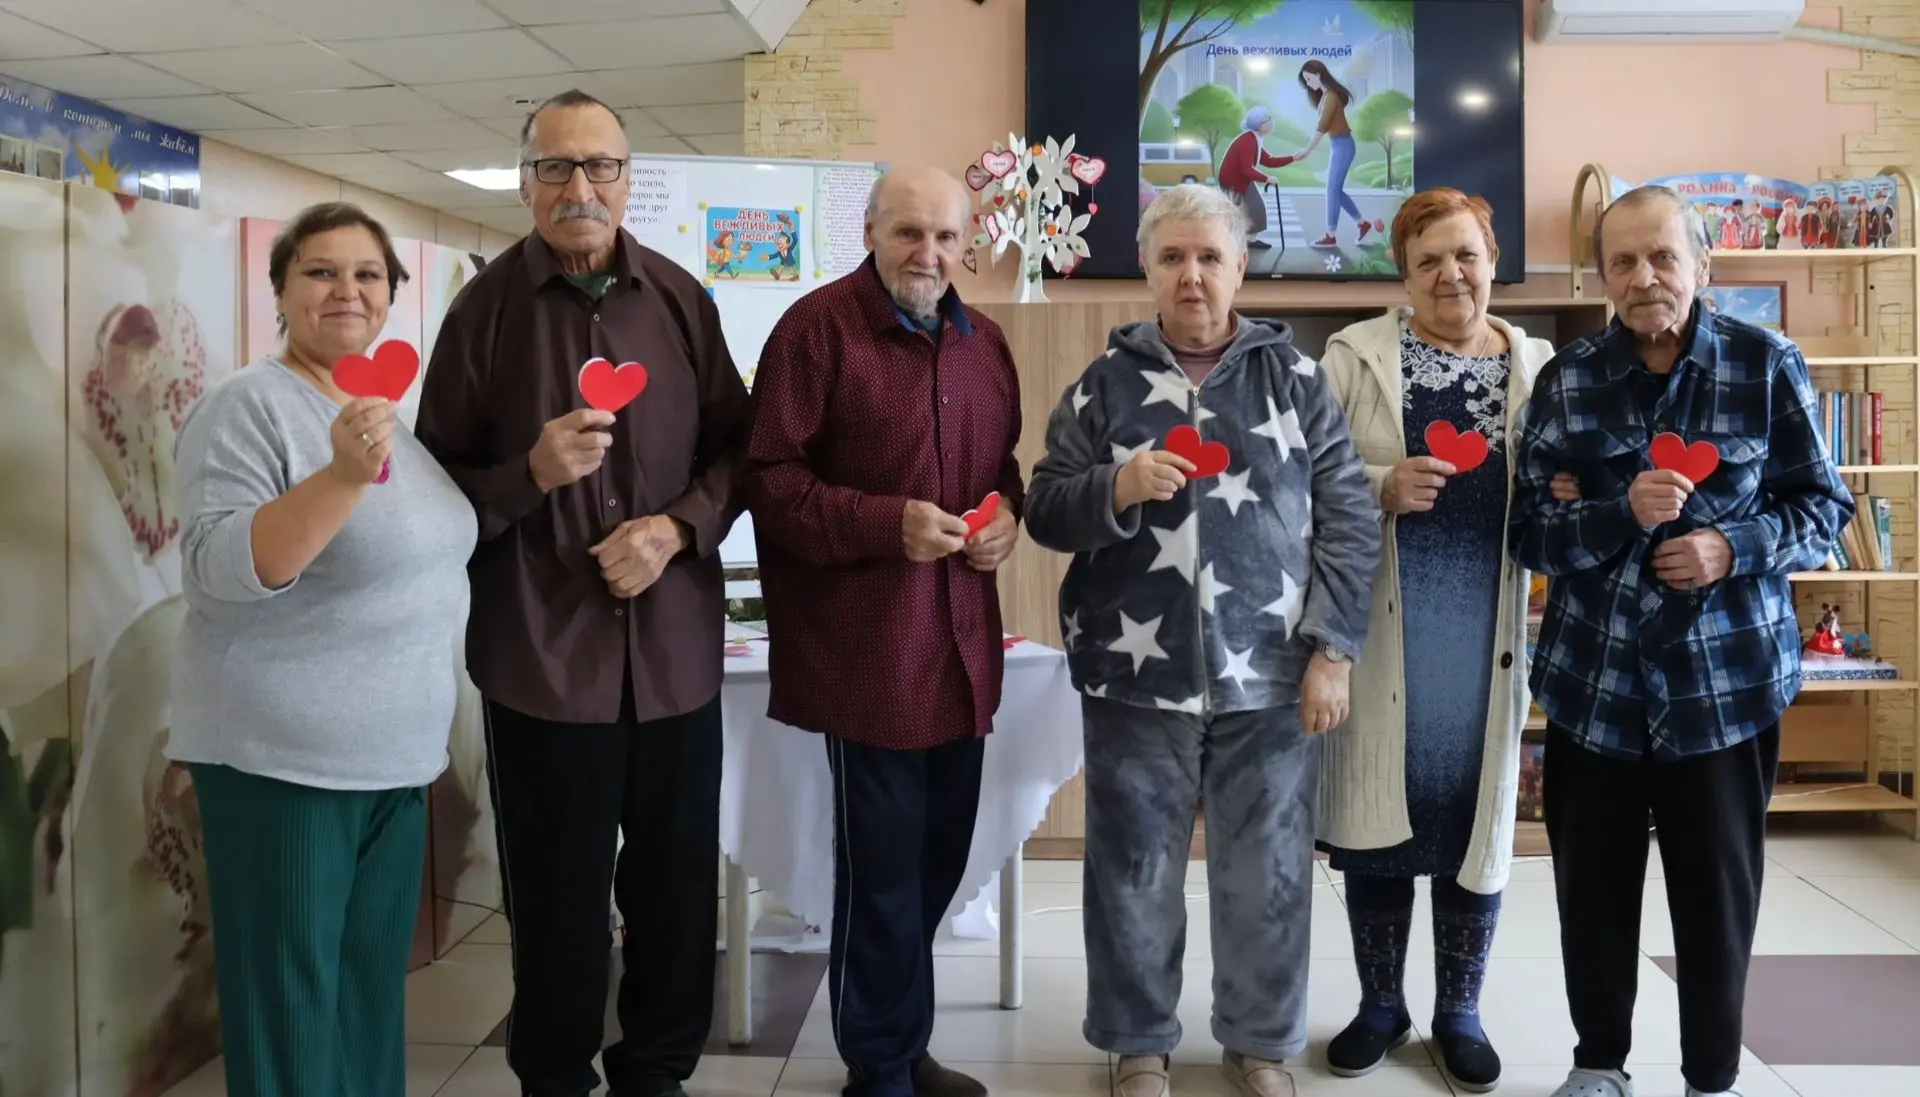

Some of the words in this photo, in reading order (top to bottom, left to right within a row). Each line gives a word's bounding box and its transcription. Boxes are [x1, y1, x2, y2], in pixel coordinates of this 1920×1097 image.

[1206, 44, 1239, 57] День
[1242, 45, 1307, 56] вежливых
[1310, 45, 1352, 58] людей
[737, 210, 769, 220] ДЕНЬ
[714, 220, 784, 231] ВЕЖЛИВЫХ
[739, 231, 775, 242] ЛЮДЕЙ
